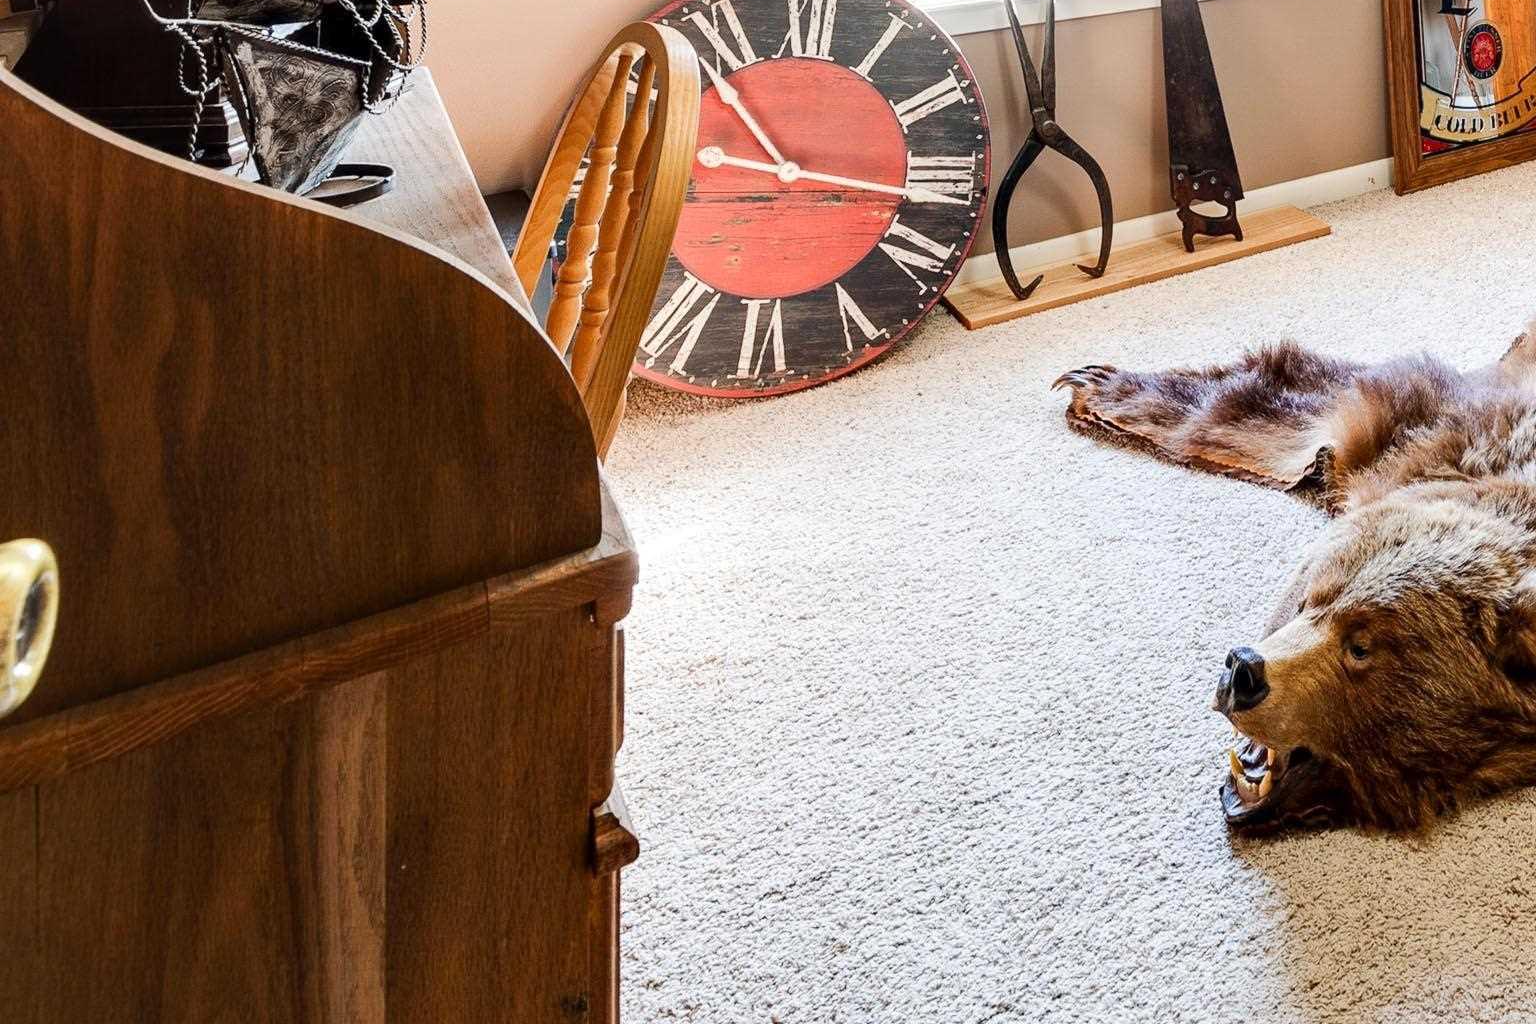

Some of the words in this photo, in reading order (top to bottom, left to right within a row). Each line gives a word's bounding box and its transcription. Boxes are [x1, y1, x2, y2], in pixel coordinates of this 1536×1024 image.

[889, 69, 968, 133] II
[1434, 113, 1484, 134] COLD
[878, 214, 956, 295] IV
[728, 299, 795, 379] VI
[835, 281, 889, 352] V
